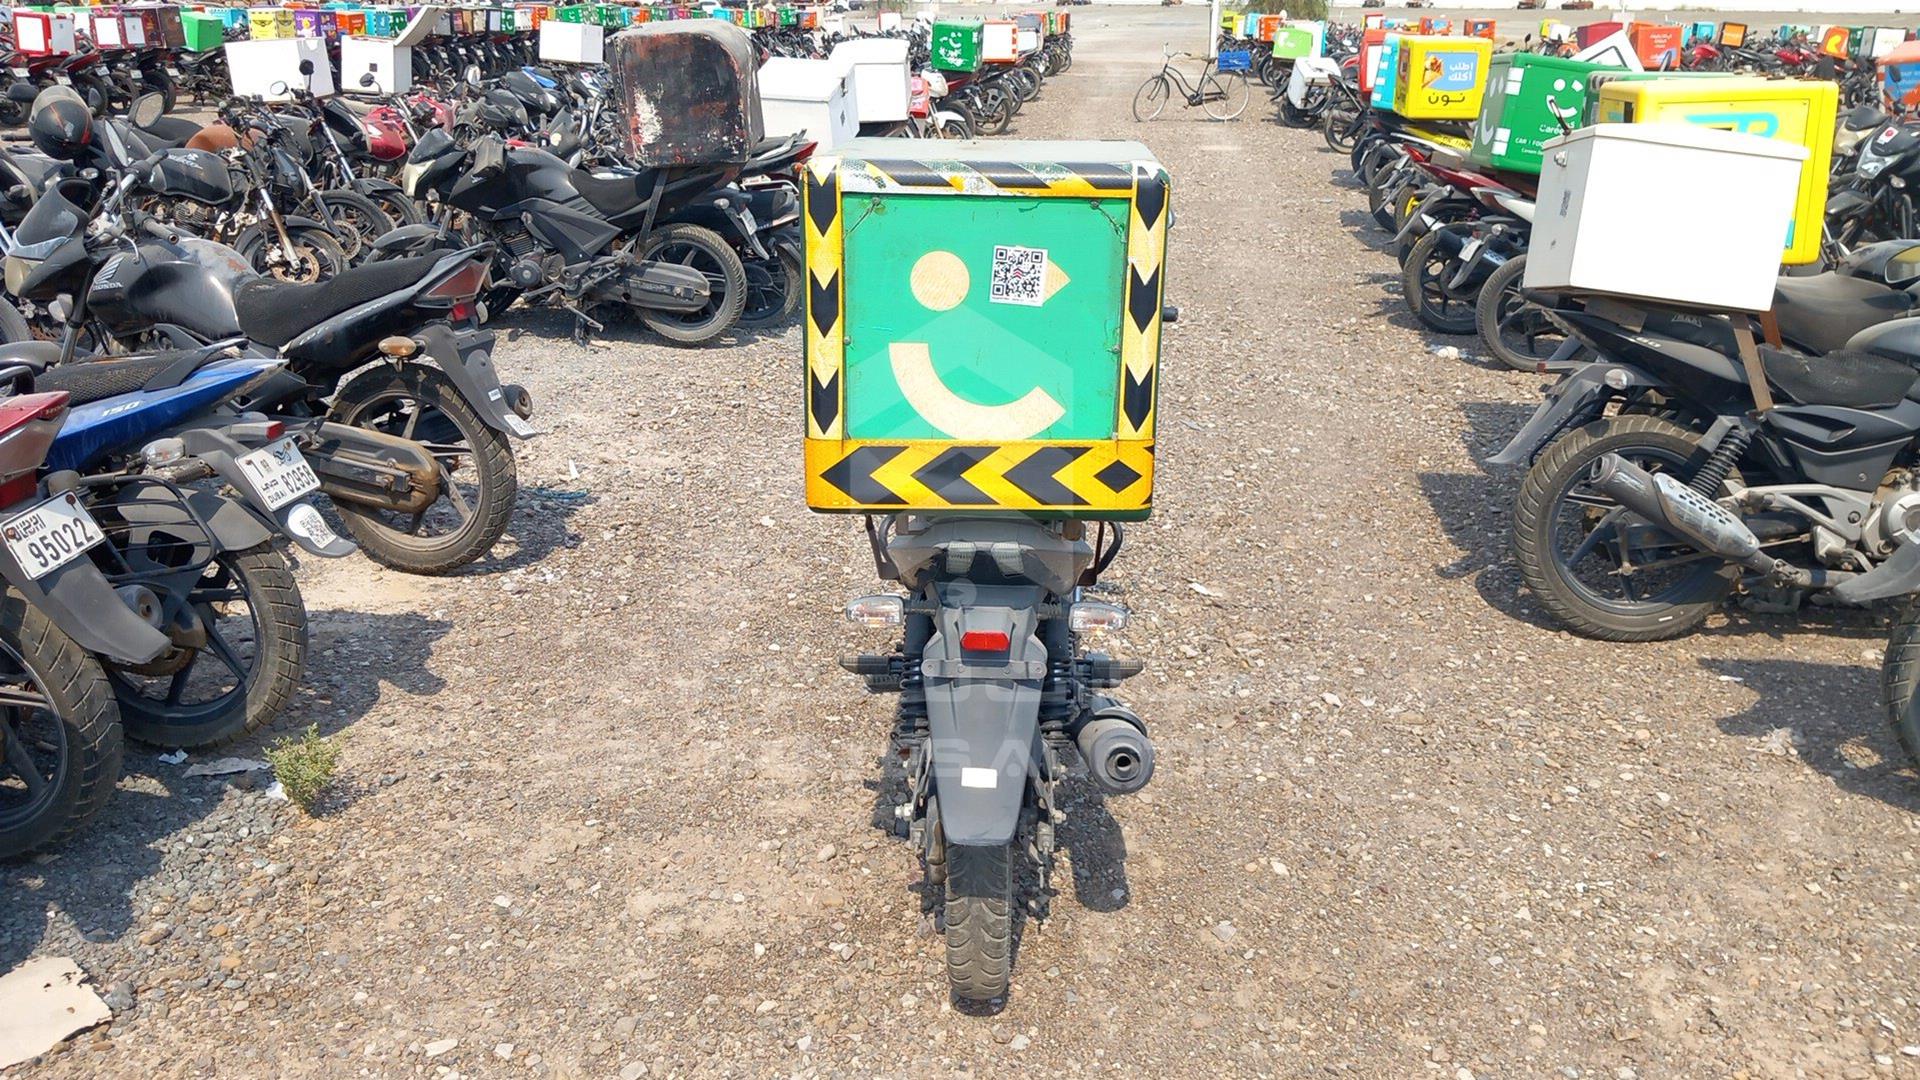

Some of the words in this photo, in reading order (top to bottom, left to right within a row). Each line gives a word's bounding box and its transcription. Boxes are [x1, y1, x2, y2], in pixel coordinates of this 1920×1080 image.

[1428, 92, 1465, 106] نون
[1515, 137, 1527, 145] CAR
[102, 400, 142, 417] 150
[281, 465, 316, 494] 82958
[267, 490, 287, 504] DUBAI
[27, 517, 95, 568] 95022
